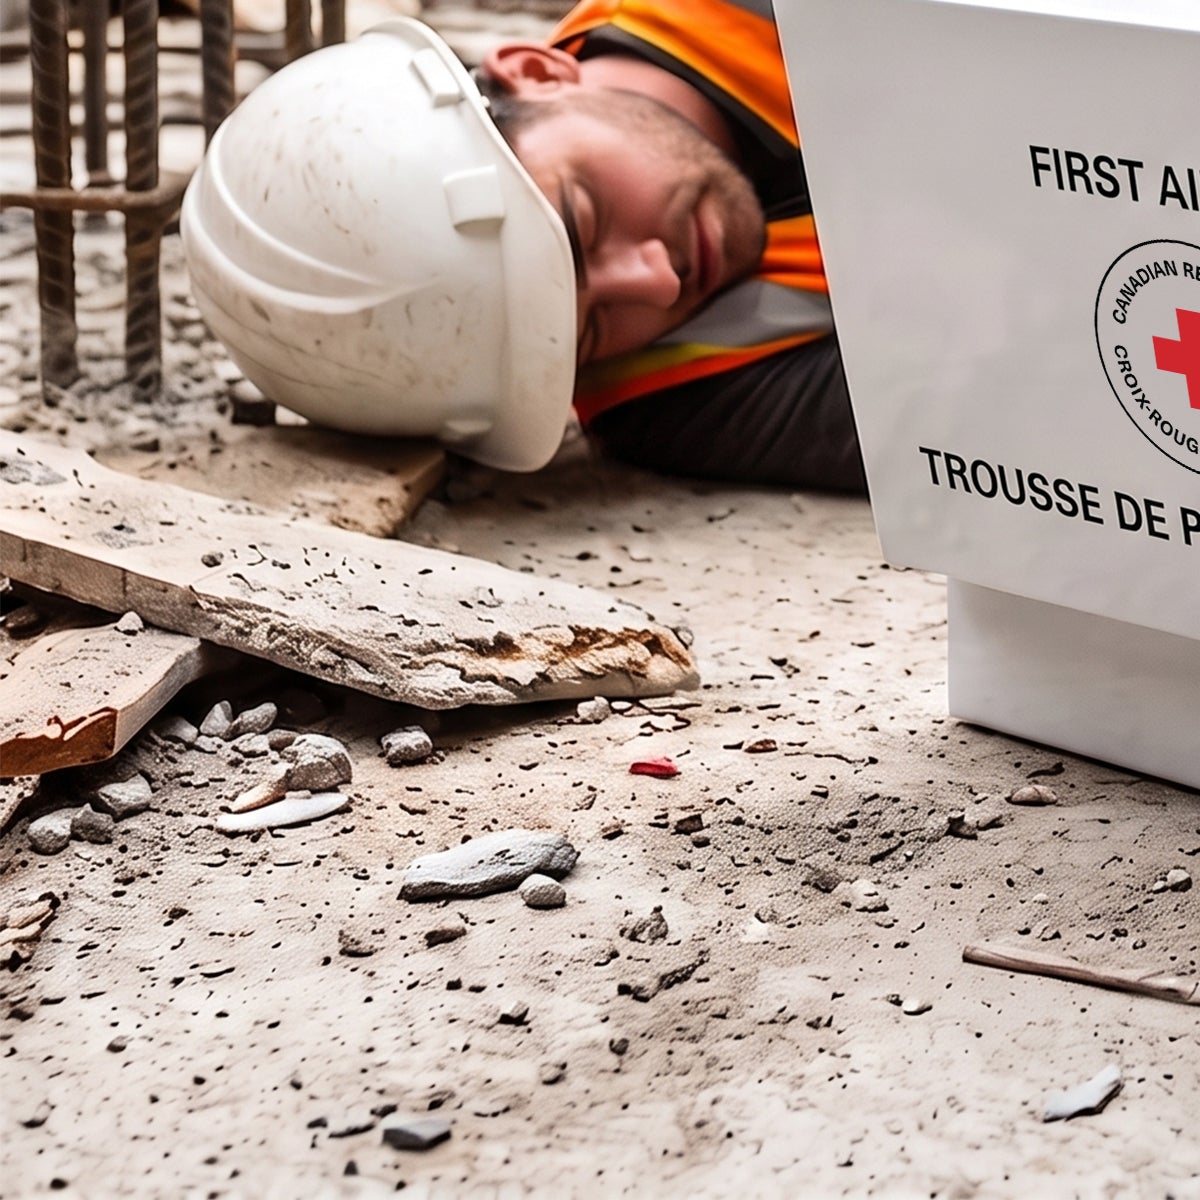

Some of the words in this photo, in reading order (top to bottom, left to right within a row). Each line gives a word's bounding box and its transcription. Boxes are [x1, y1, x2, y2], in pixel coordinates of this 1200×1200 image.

[1028, 144, 1144, 202] FIRST
[1112, 259, 1179, 325] CANADIAN
[918, 446, 1105, 525] TROUSSE
[1113, 490, 1170, 541] DE
